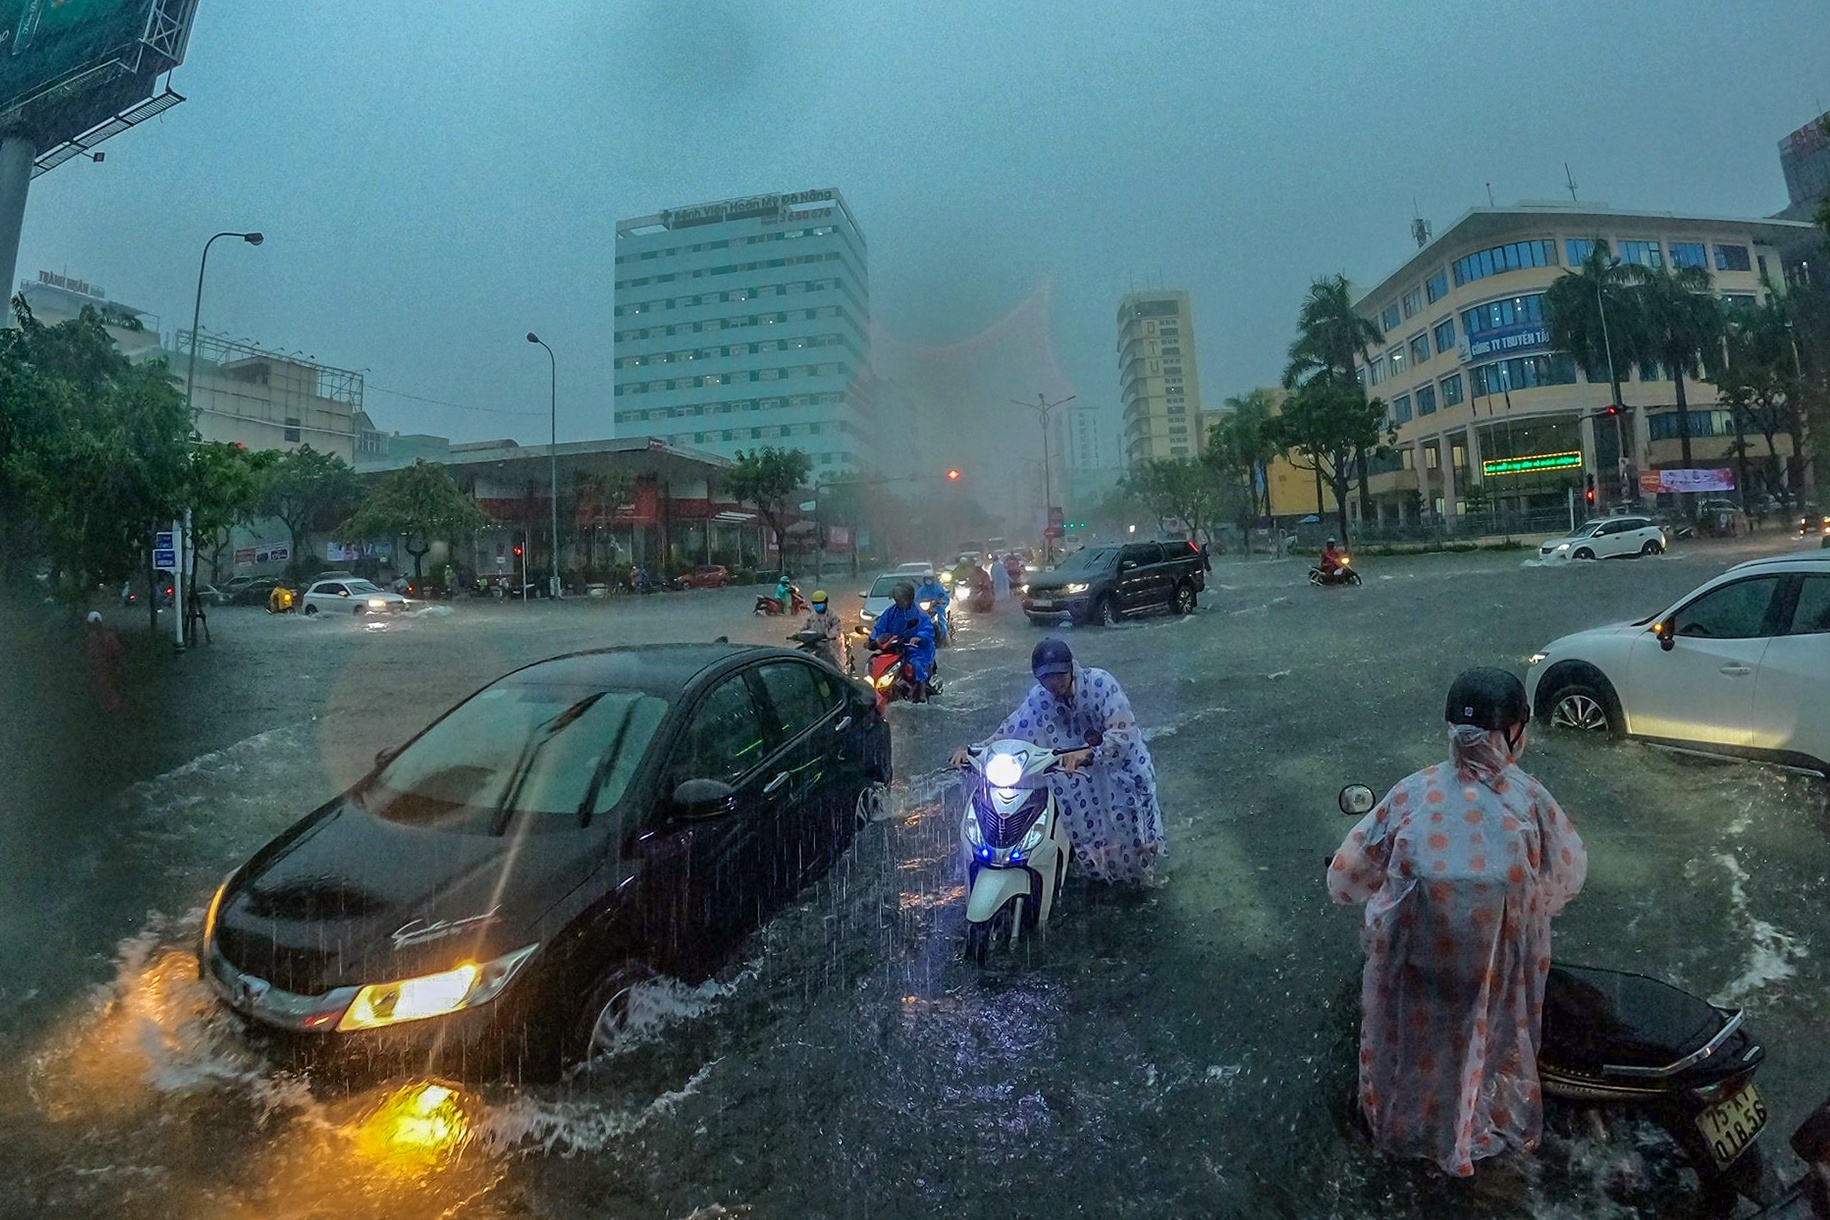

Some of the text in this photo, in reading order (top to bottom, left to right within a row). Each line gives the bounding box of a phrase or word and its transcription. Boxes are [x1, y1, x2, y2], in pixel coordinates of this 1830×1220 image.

[703, 201, 728, 217] Viện
[781, 192, 798, 204] Đà
[800, 189, 832, 203] Nẵng
[1471, 341, 1491, 356] CÔNG
[1491, 338, 1501, 351] TY
